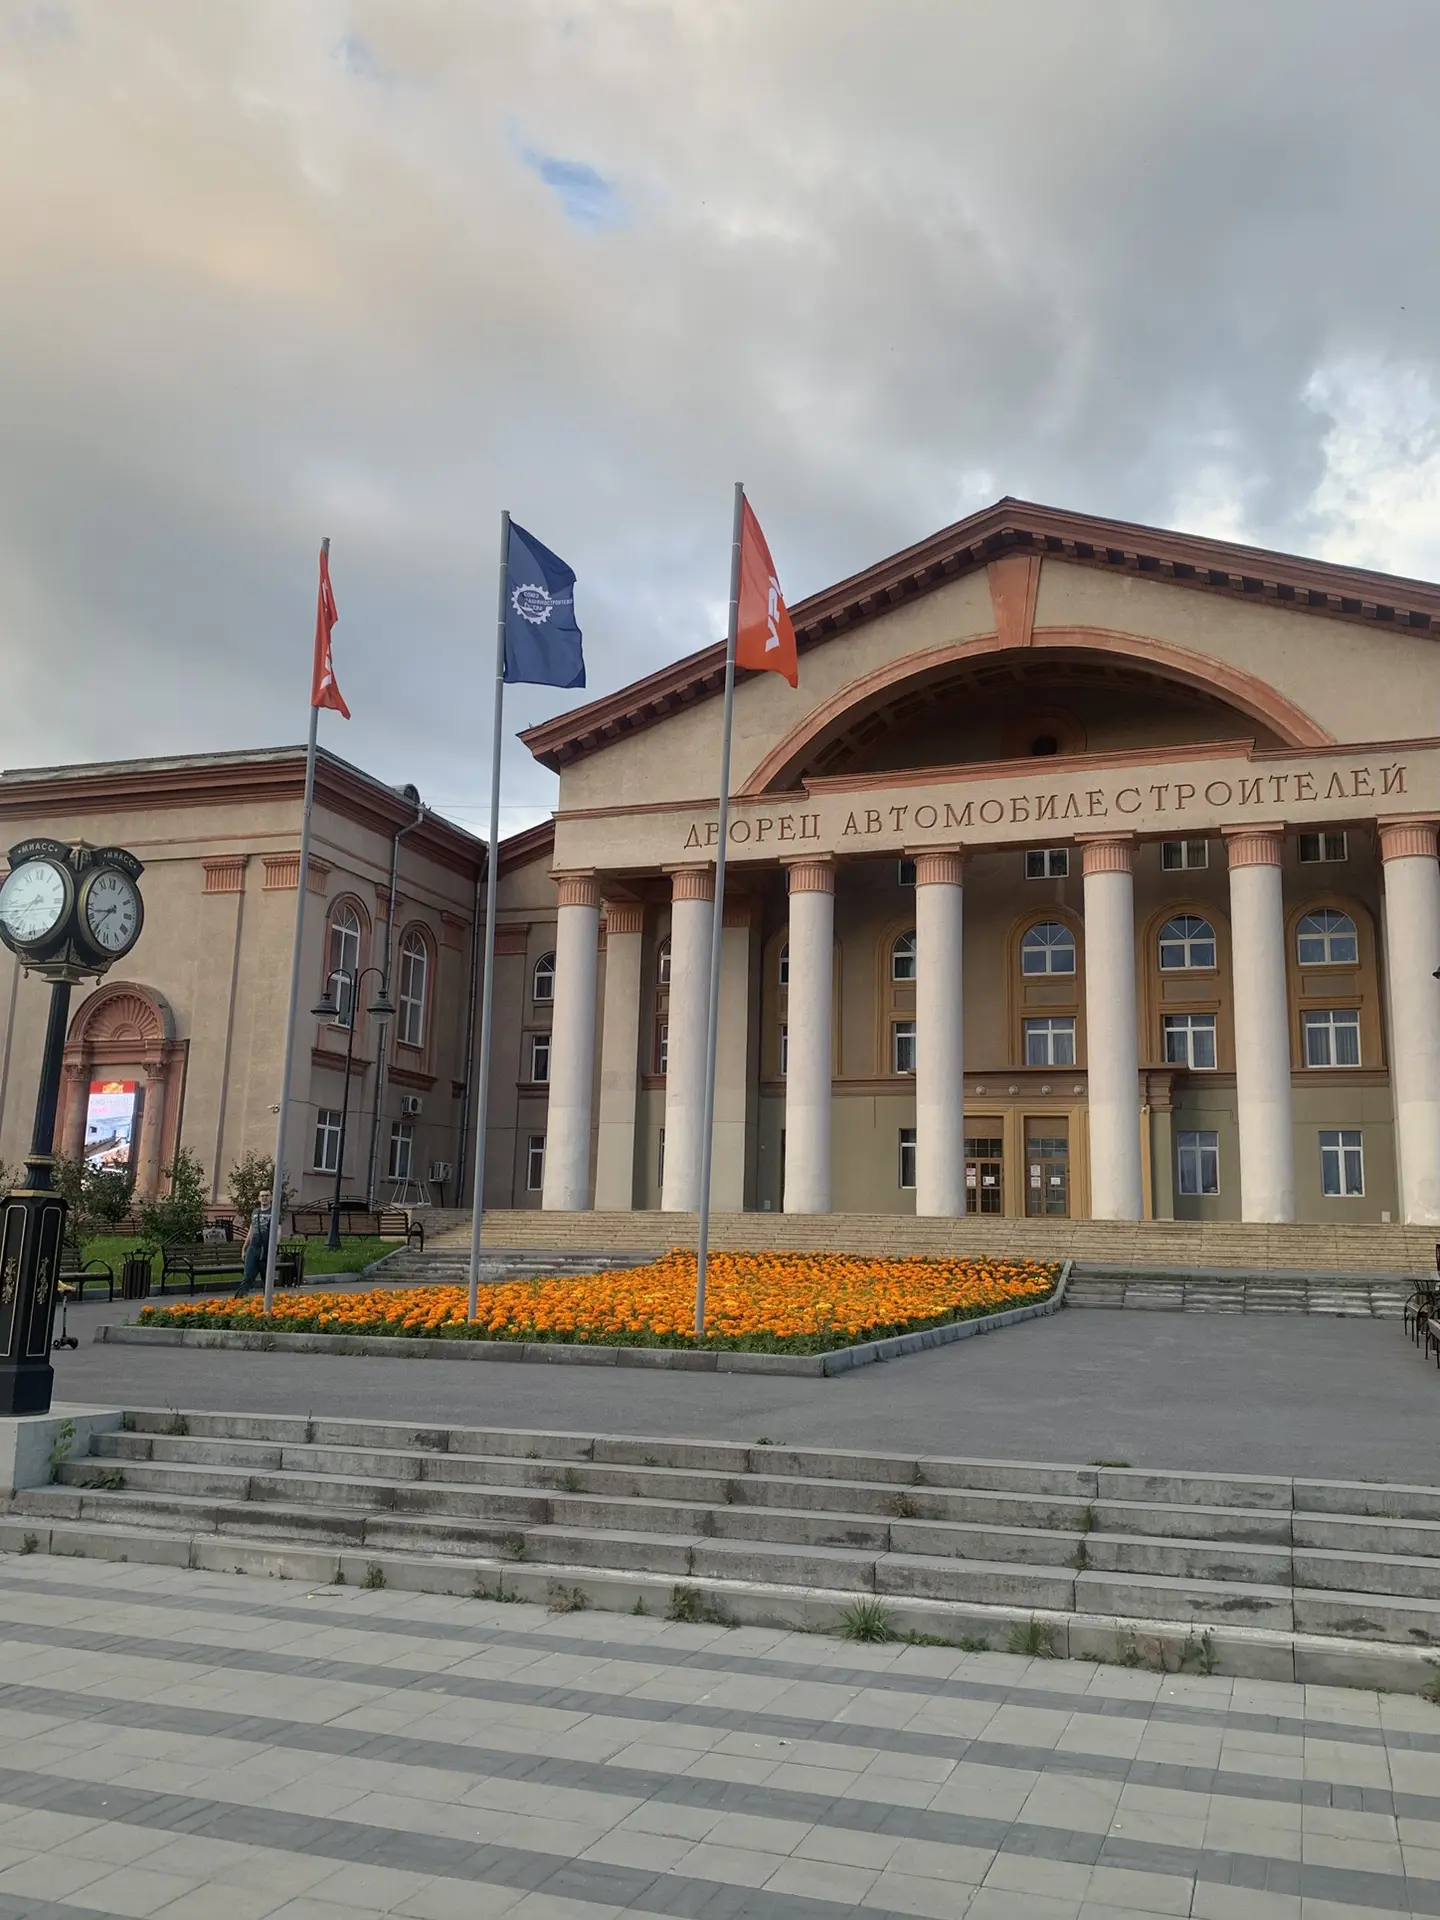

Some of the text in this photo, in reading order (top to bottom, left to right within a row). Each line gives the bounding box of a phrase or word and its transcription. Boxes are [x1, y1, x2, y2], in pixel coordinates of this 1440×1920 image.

[684, 762, 1407, 849] ДВОРЕЦ АВТОМОБИЛЕСТРОИТЕЛЕЙ
[21, 842, 55, 853] МИАСС
[107, 851, 134, 867] МИАСС
